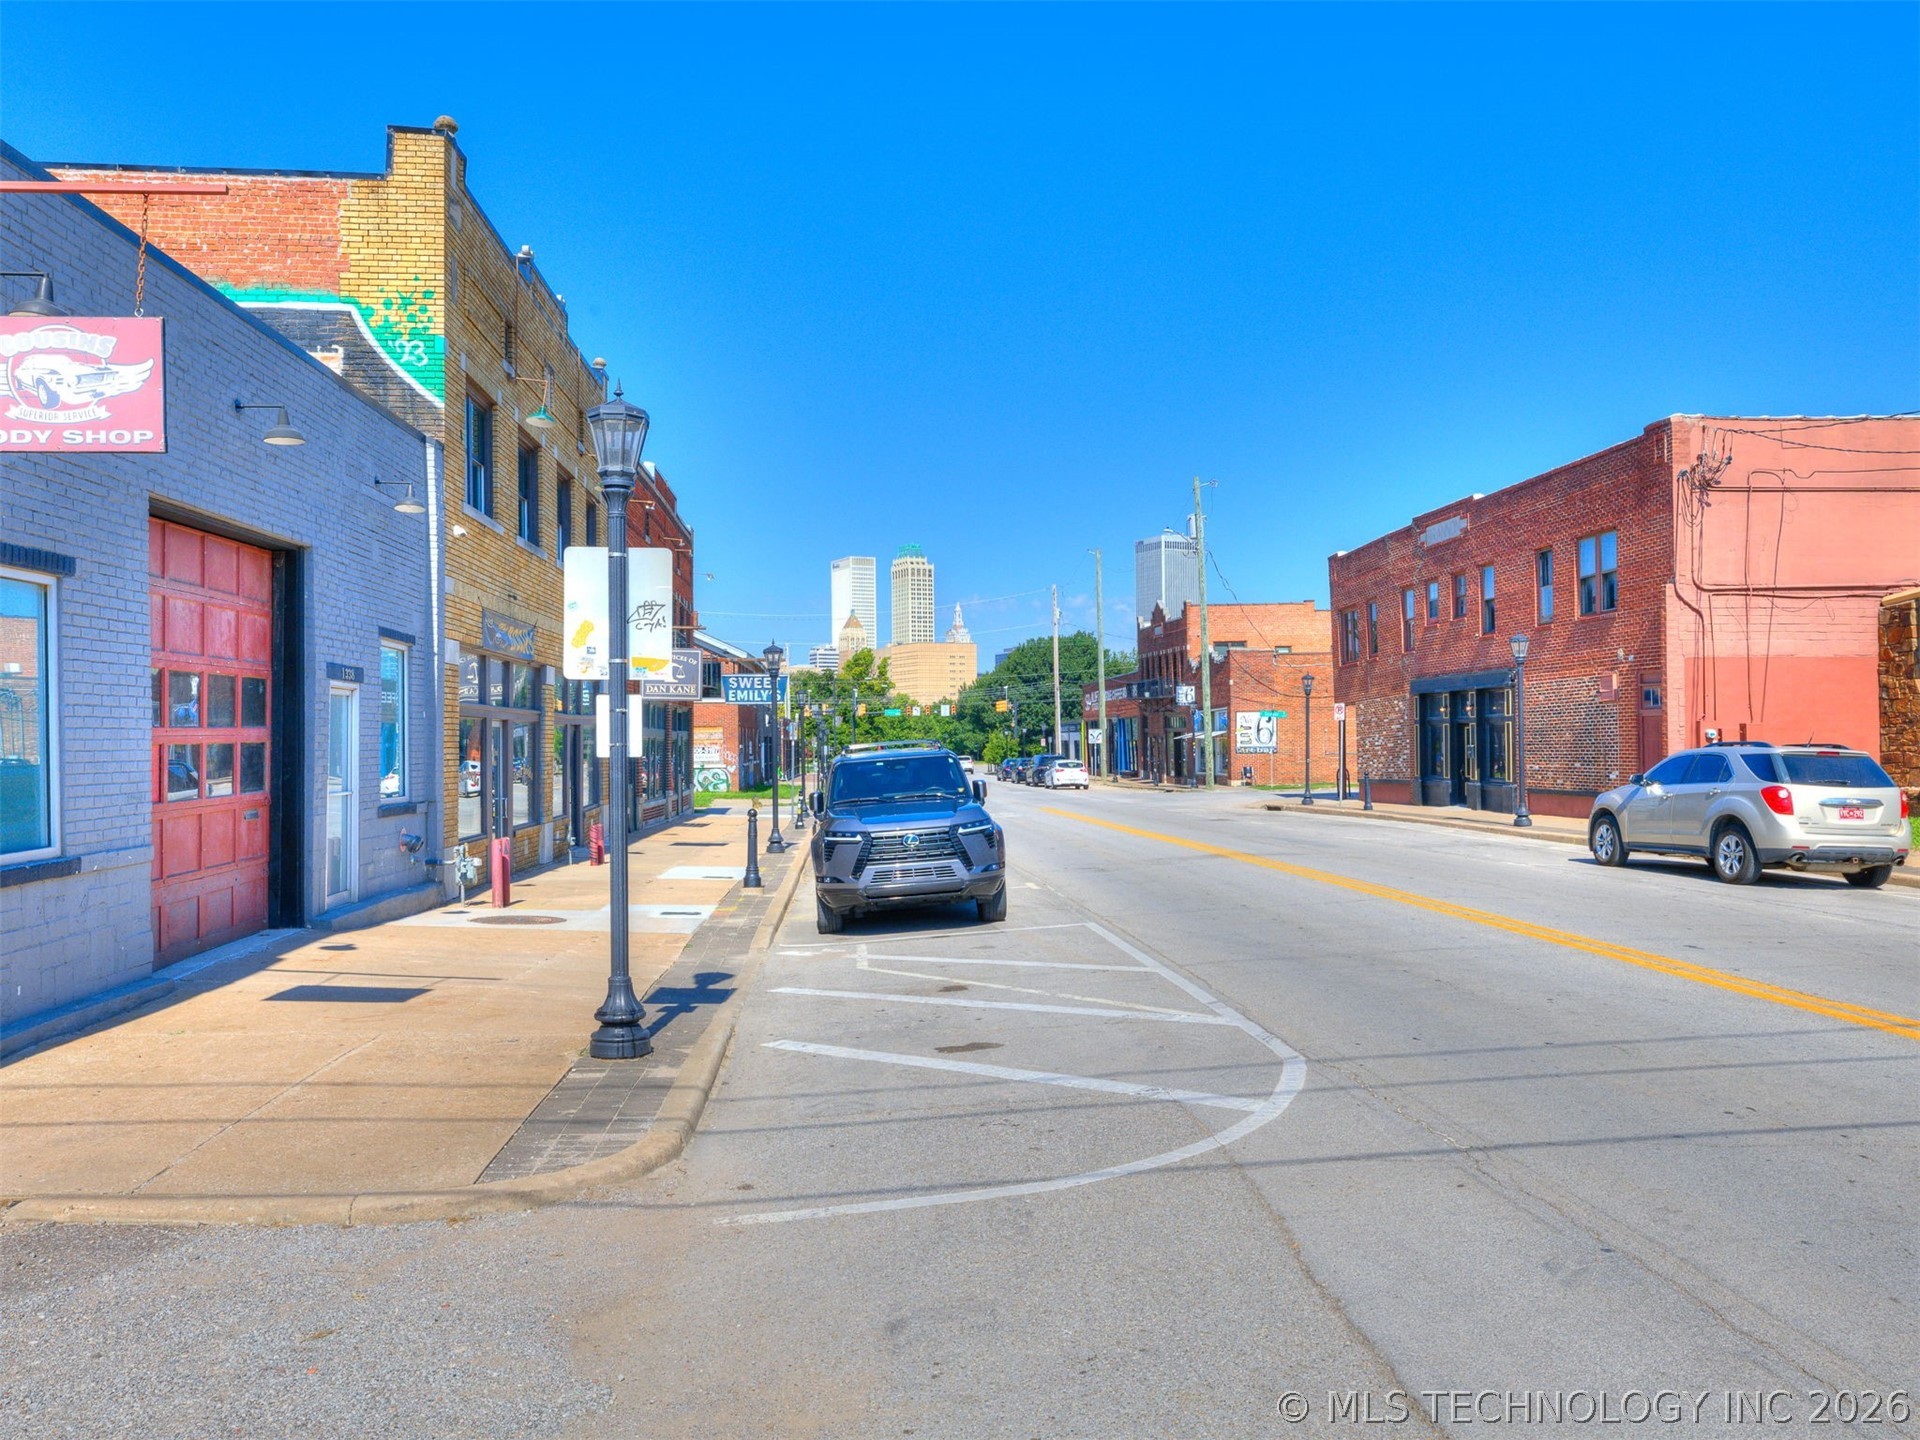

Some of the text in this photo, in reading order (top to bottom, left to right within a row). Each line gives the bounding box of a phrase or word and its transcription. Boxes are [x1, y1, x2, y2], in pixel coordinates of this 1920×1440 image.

[18, 408, 97, 421] SUPERIOR SERVICE
[62, 430, 154, 445] SHOP
[672, 654, 688, 663] ICES
[646, 684, 697, 694] DAN KANE
